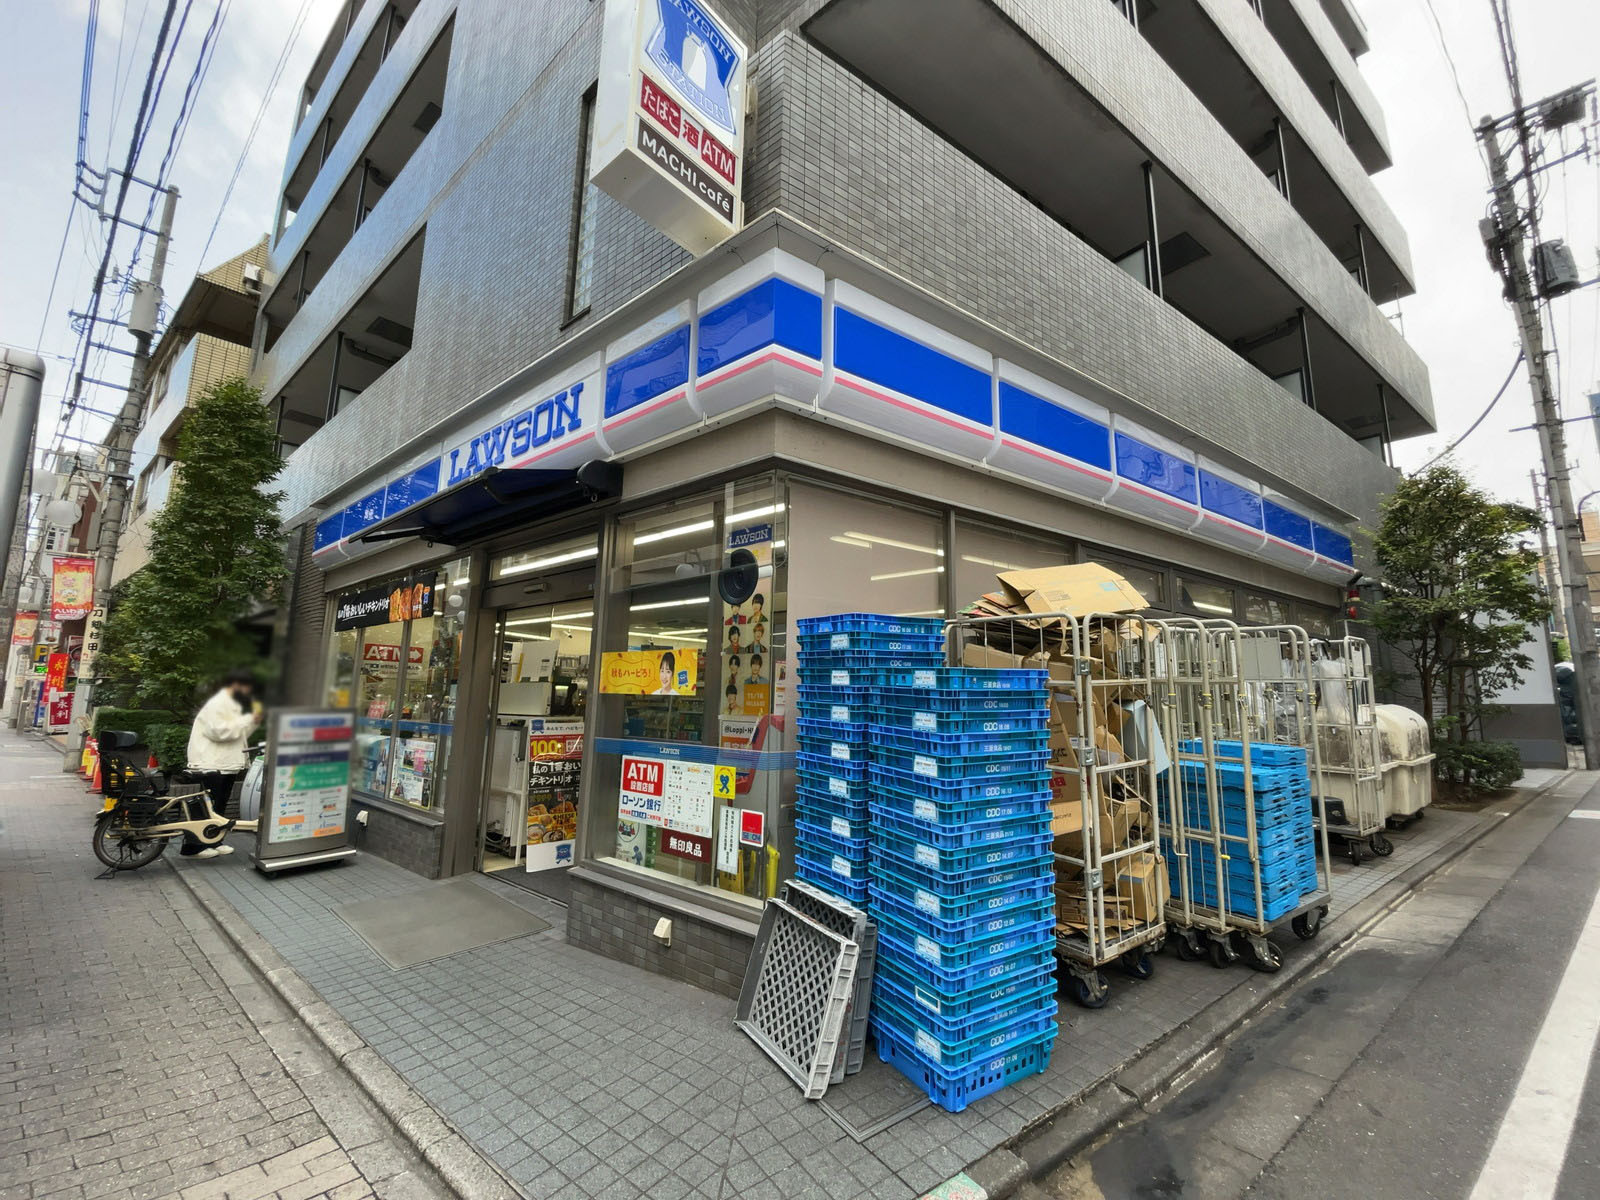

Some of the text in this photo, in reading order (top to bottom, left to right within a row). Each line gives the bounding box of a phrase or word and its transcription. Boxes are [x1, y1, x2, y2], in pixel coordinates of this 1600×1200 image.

[668, 0, 732, 63] AWSON
[657, 48, 727, 122] STATION
[642, 85, 680, 132] たばこ
[683, 121, 699, 148] 酒
[703, 141, 734, 178] ATM
[642, 130, 730, 212] MACHI café
[447, 382, 585, 486] LAWSON
[729, 528, 769, 546] LAWSON
[888, 625, 901, 633] CDC
[889, 642, 902, 650] CDC
[984, 700, 998, 708] CDC
[983, 722, 998, 731] CDC
[627, 762, 659, 783] ATM
[985, 764, 1000, 773] CDC
[530, 775, 573, 787] チキントリオ
[986, 787, 1000, 796] CDC
[621, 795, 662, 812] ローソン銀行
[986, 808, 1001, 817] CDC
[669, 836, 703, 858] 無印良品
[987, 852, 1002, 863] CDC
[988, 874, 1003, 884] CDC
[988, 897, 1003, 908] CDC
[988, 919, 1003, 931] CDC
[989, 942, 1004, 954] CDC
[989, 964, 1004, 977] CDC
[990, 987, 1004, 999] CDC
[990, 1033, 1005, 1047] CDC
[990, 1057, 1005, 1070] CDC
